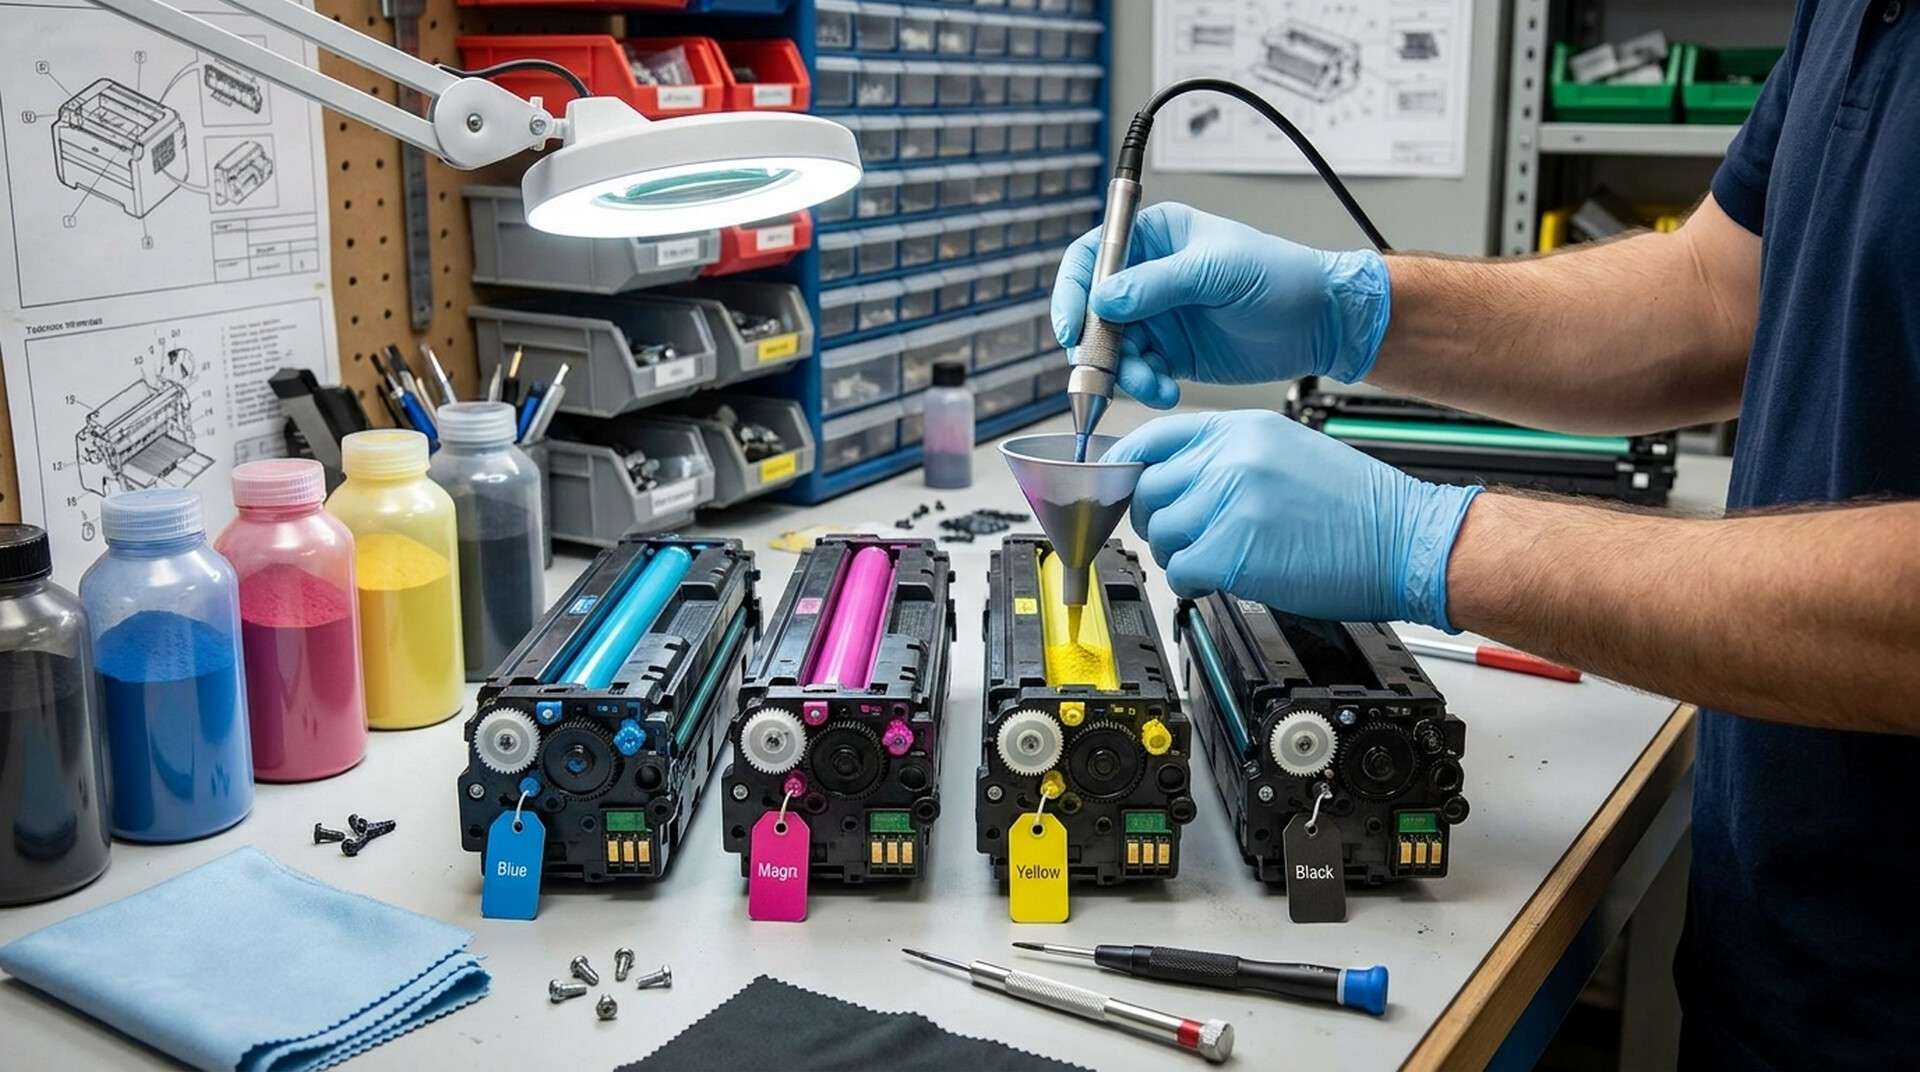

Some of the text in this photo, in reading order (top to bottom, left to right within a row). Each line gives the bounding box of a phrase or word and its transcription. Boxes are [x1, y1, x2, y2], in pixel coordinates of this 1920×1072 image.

[497, 860, 528, 878] Blue
[757, 862, 799, 882] Magn
[1016, 864, 1061, 880] Yellow
[1295, 864, 1335, 880] Black
